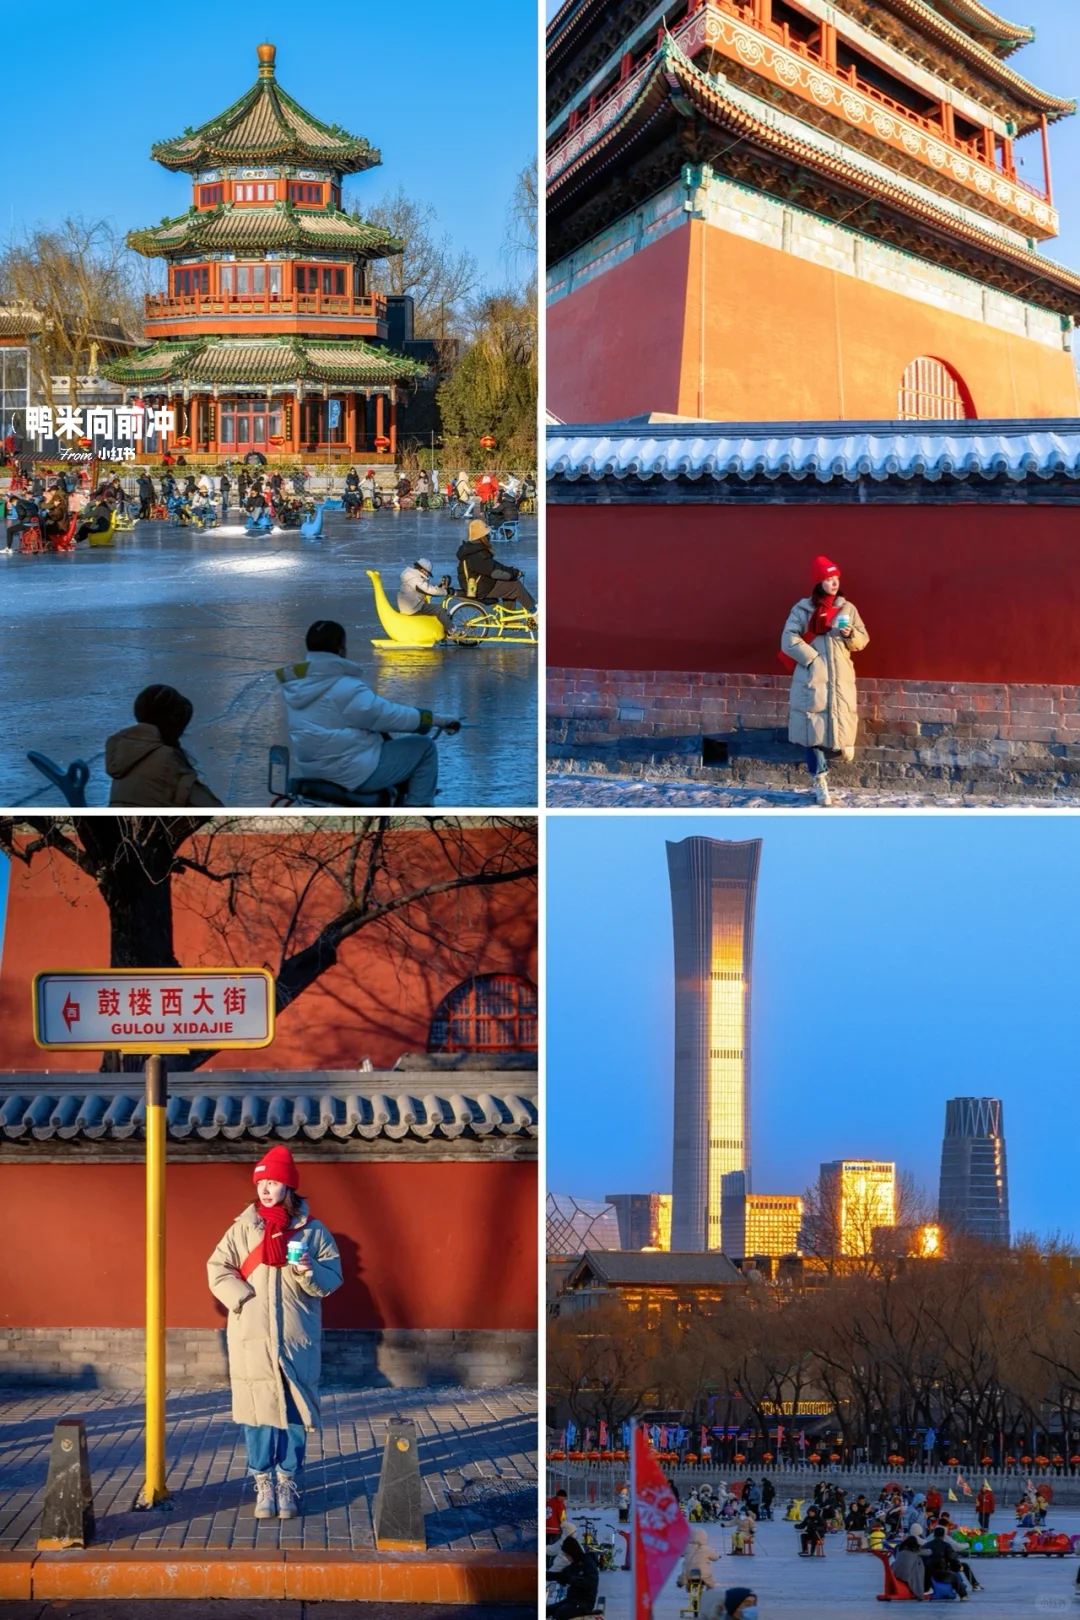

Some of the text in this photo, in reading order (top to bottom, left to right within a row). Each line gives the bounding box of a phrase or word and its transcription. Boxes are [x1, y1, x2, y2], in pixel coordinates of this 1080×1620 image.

[97, 986, 247, 1017] 鼓楼西大街
[111, 1022, 233, 1035] GULOU XIDAJIE
